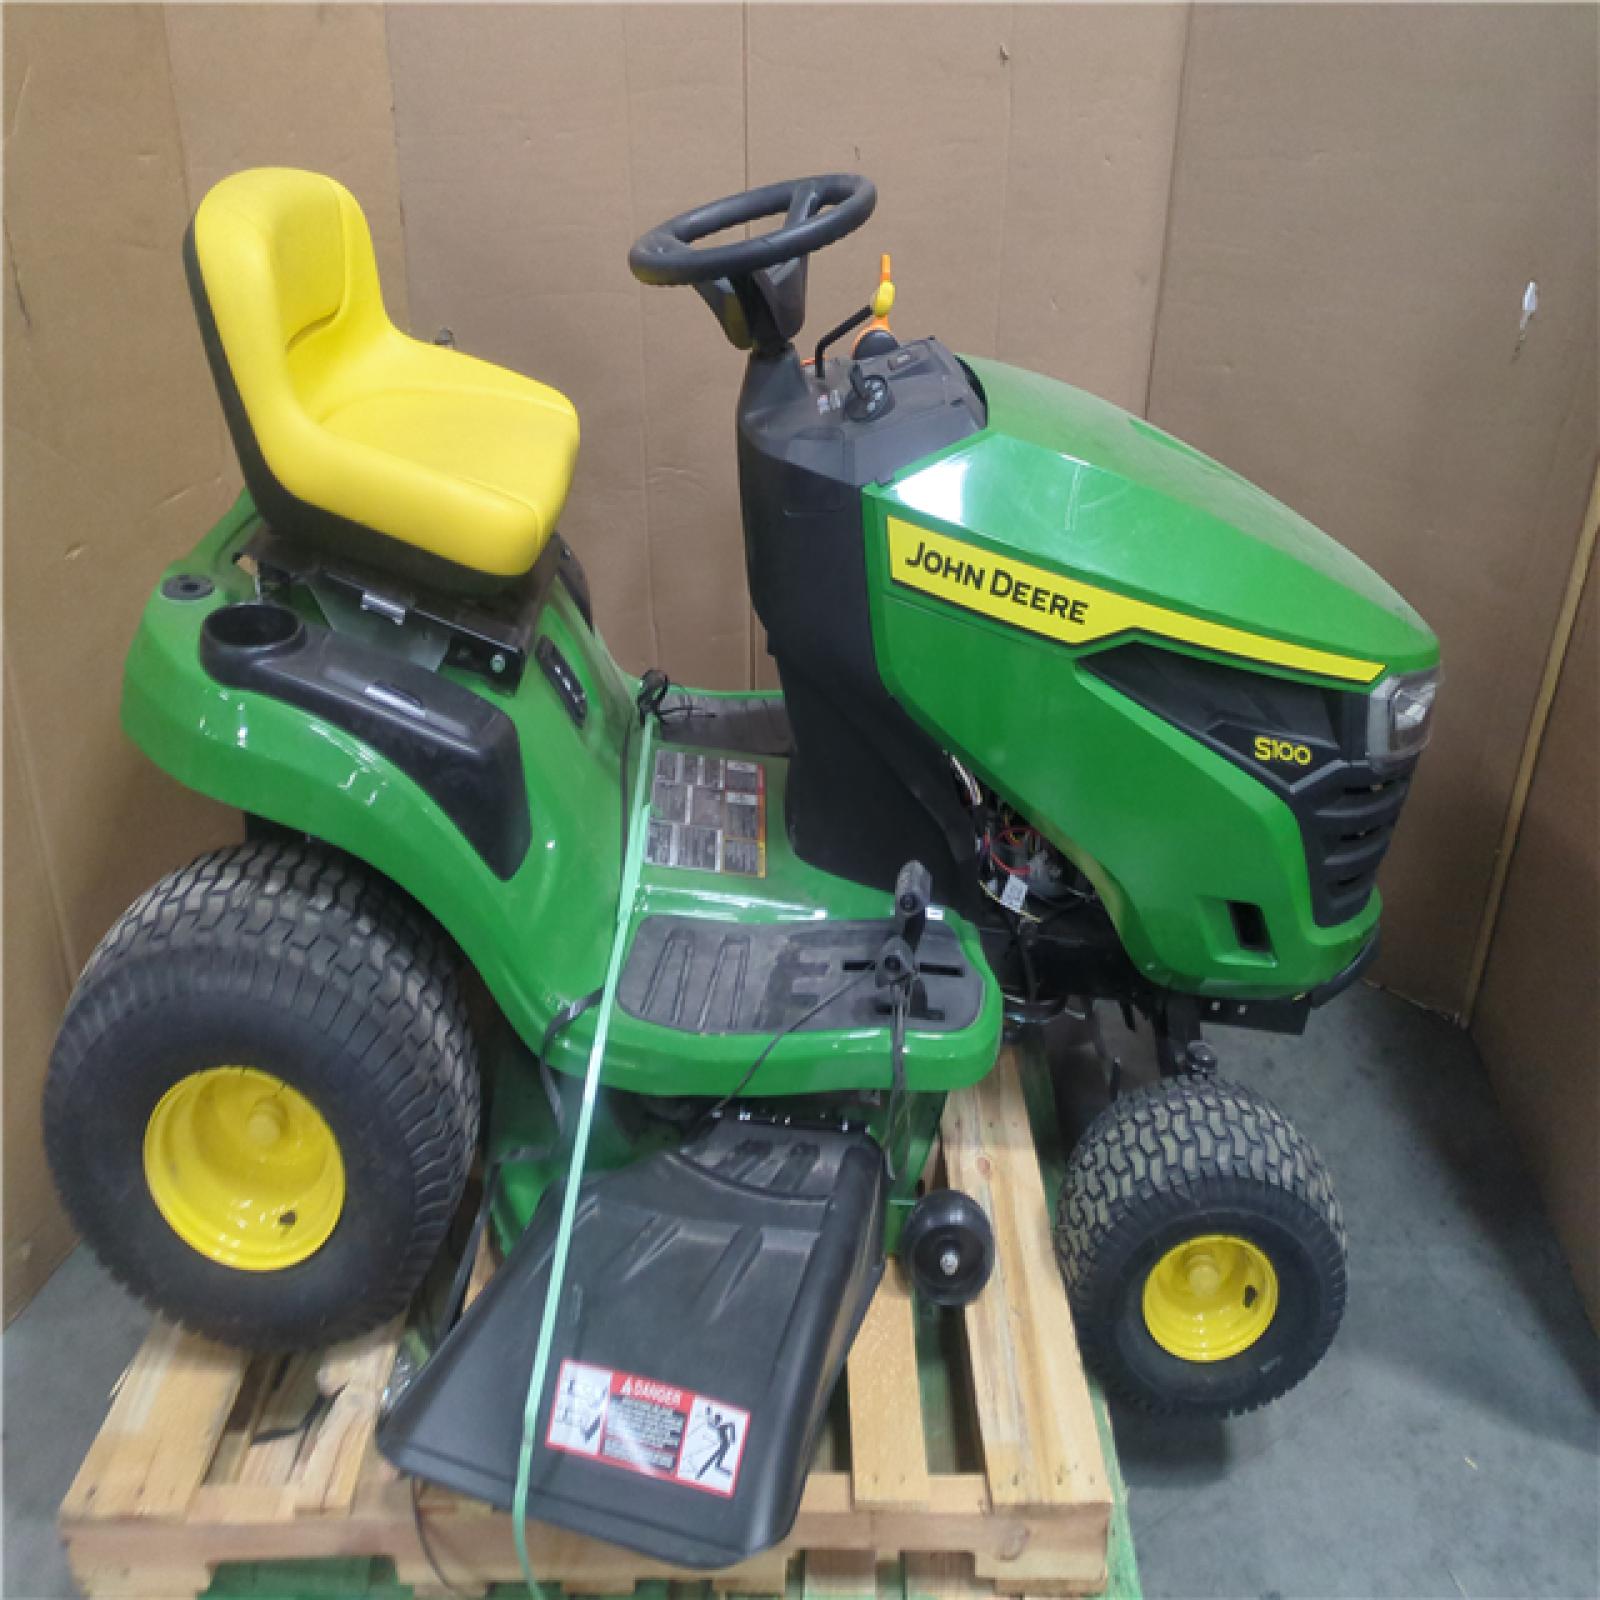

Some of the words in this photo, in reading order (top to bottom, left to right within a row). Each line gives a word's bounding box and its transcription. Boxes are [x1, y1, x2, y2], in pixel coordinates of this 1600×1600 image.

[905, 541, 985, 591] JOHN
[990, 568, 1089, 624] DEERE
[1254, 736, 1312, 766] S100
